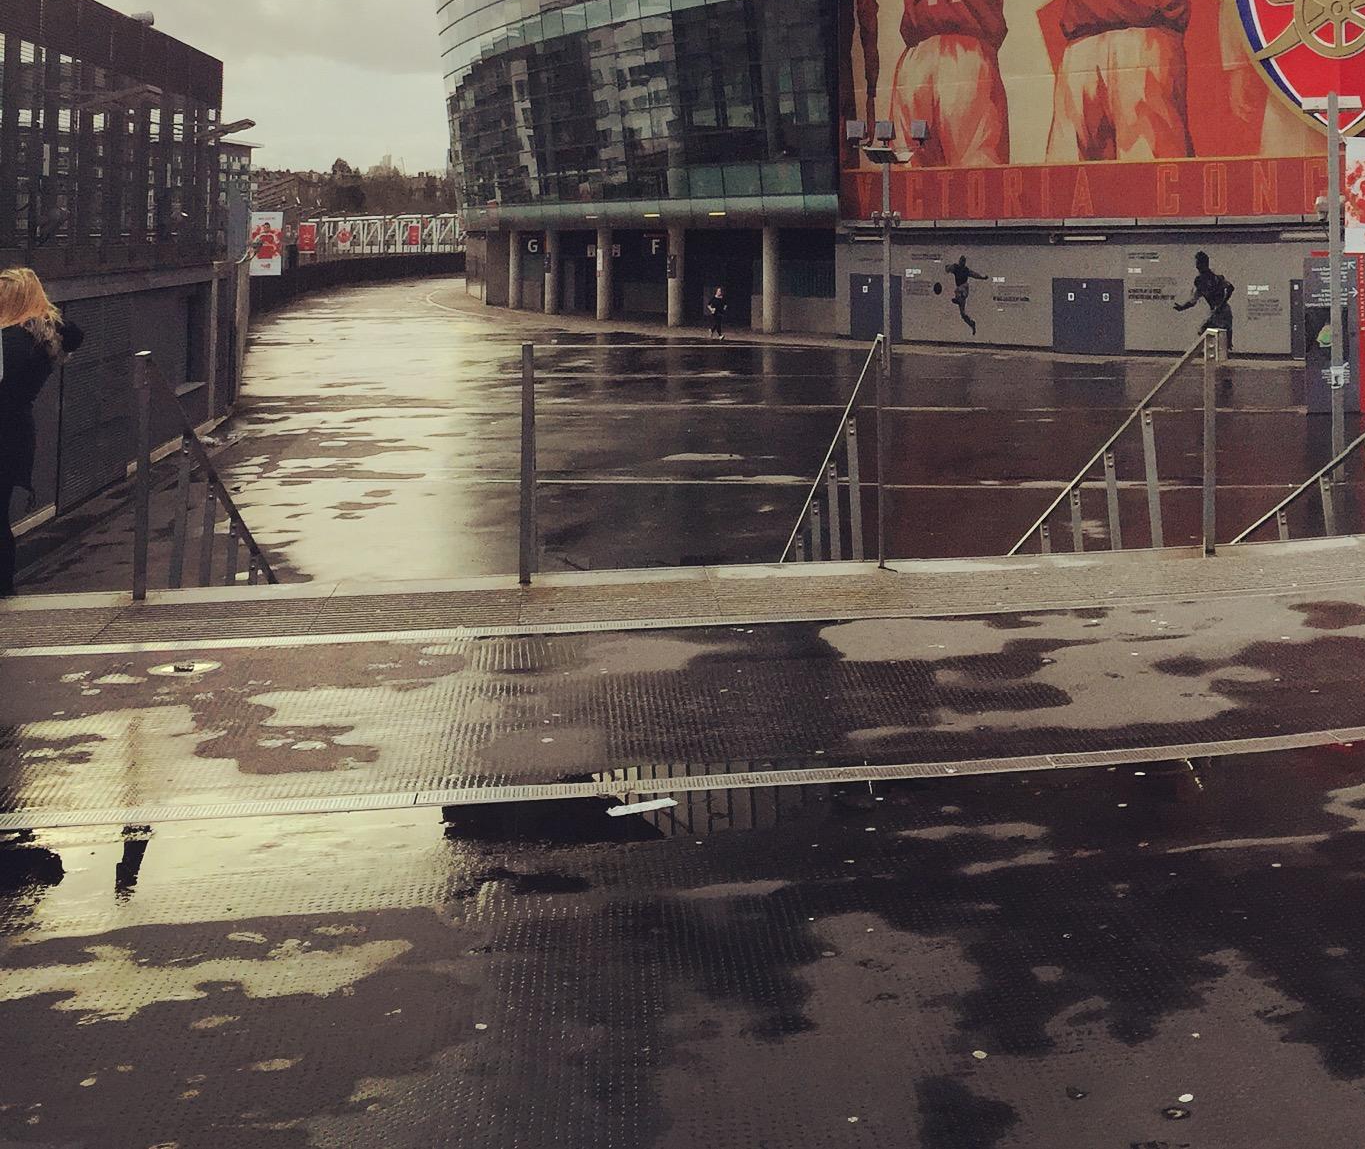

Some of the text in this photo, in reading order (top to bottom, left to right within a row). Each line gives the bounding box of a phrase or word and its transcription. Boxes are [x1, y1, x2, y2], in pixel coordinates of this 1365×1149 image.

[857, 166, 1095, 220] VCTORIA
[527, 239, 538, 253] G
[652, 239, 660, 254] F
